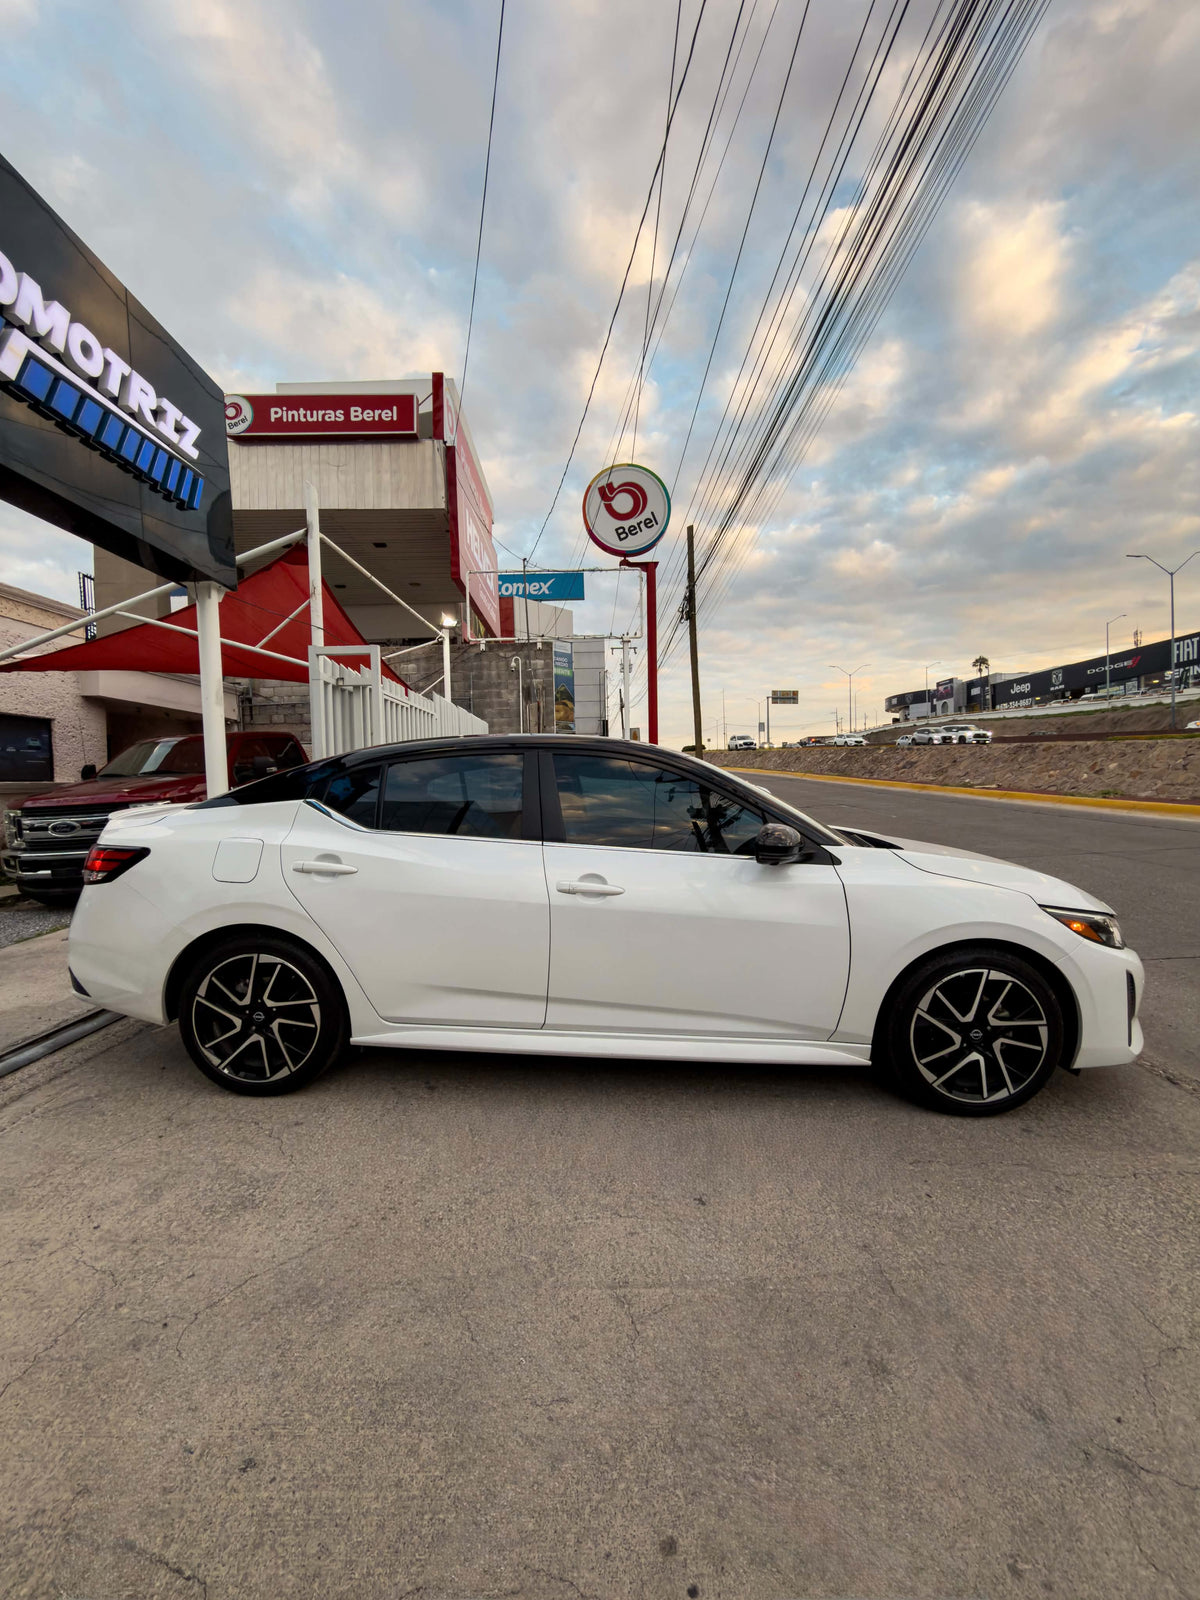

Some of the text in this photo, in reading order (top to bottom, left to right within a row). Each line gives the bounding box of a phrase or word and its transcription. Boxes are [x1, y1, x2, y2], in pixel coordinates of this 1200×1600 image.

[270, 406, 397, 422] Pinturas Berel
[228, 415, 248, 430] Berel
[614, 511, 659, 542] Berel
[1174, 637, 1200, 663] FIAT
[1087, 659, 1133, 675] DODGE
[1010, 682, 1031, 695] Jeep
